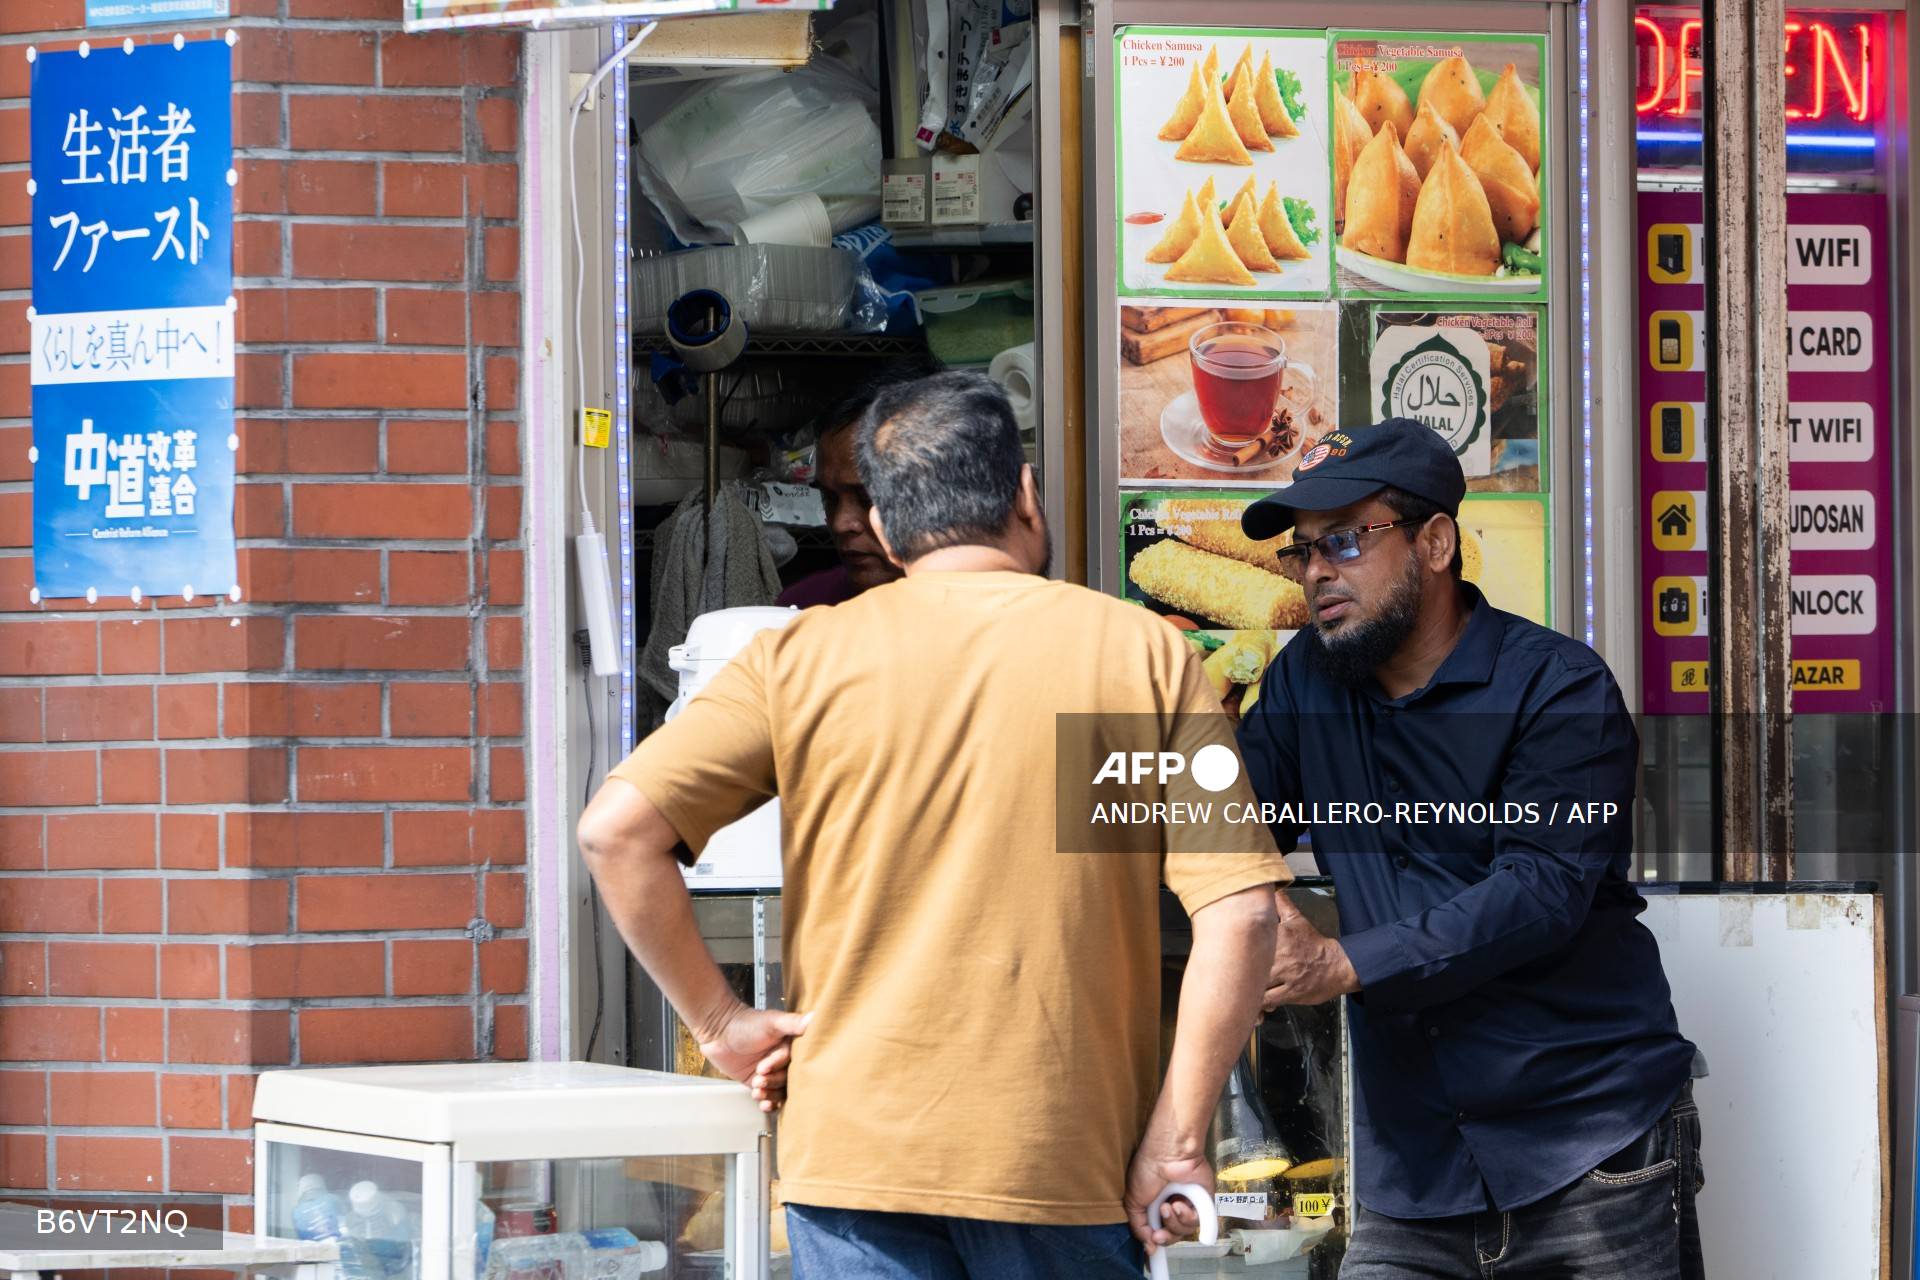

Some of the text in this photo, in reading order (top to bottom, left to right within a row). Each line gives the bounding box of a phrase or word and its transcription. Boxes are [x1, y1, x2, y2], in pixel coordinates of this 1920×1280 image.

[1123, 40, 1203, 51] Chicken Samusa
[1377, 45, 1425, 59] Vegetable
[1427, 45, 1464, 57] Samusa
[1132, 56, 1148, 66] Pcs
[61, 102, 196, 185] 生活者
[49, 197, 210, 273] ファースト
[1796, 238, 1859, 267] WIFI
[1436, 316, 1470, 328] Chicken
[1515, 316, 1534, 328] Roll
[42, 317, 221, 374] くらしを真ん中へ！
[1799, 326, 1862, 356] CARD
[1405, 354, 1456, 374] Certification
[1455, 366, 1474, 406] Services
[1407, 374, 1461, 411] حلال
[1808, 418, 1861, 443] WIFI
[64, 418, 198, 519] 中道 改革
[148, 473, 198, 516] 連合
[1138, 525, 1155, 536] Pcs
[1789, 504, 1863, 533] UDOSAN
[1792, 590, 1864, 615] NLOCK
[1793, 666, 1844, 685] AZAR
